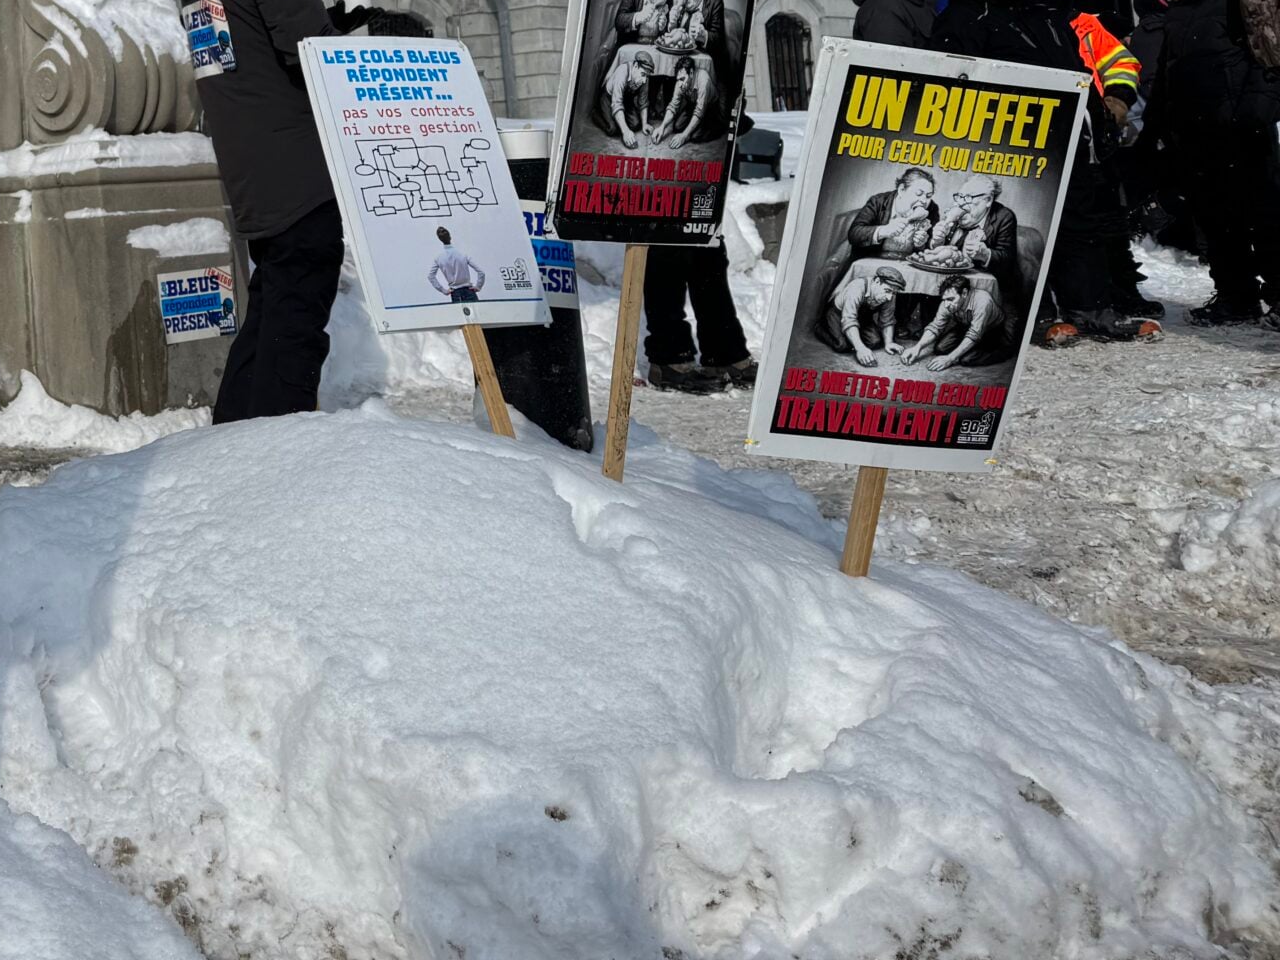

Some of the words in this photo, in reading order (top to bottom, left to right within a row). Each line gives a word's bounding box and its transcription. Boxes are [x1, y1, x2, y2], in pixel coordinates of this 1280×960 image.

[322, 50, 357, 65] LES
[360, 49, 404, 64] COLS
[406, 50, 461, 64] BLEUS
[346, 65, 448, 83] RÉPONDENT
[342, 108, 368, 122] pas
[376, 107, 402, 118] vos
[411, 105, 475, 117] contrats
[846, 74, 912, 132] UN
[913, 83, 1061, 149] BUFFET
[343, 123, 361, 136] ni
[368, 123, 411, 135] votre
[419, 121, 483, 137] gestion!
[837, 133, 886, 160] POUR
[888, 139, 936, 167] CEUX
[939, 146, 970, 172] QUI
[972, 147, 1034, 178] GÈRENT
[570, 152, 595, 176] DES
[596, 154, 646, 180] MIETTES
[646, 157, 676, 182] POUR
[677, 160, 705, 183] CEUX
[705, 161, 723, 185] QUI
[167, 275, 220, 297] BLEUS
[785, 367, 818, 392] DES
[819, 371, 890, 400] MIETTES
[891, 378, 937, 405] POUR
[937, 383, 980, 409] CEUX
[979, 386, 1009, 410] QUI
